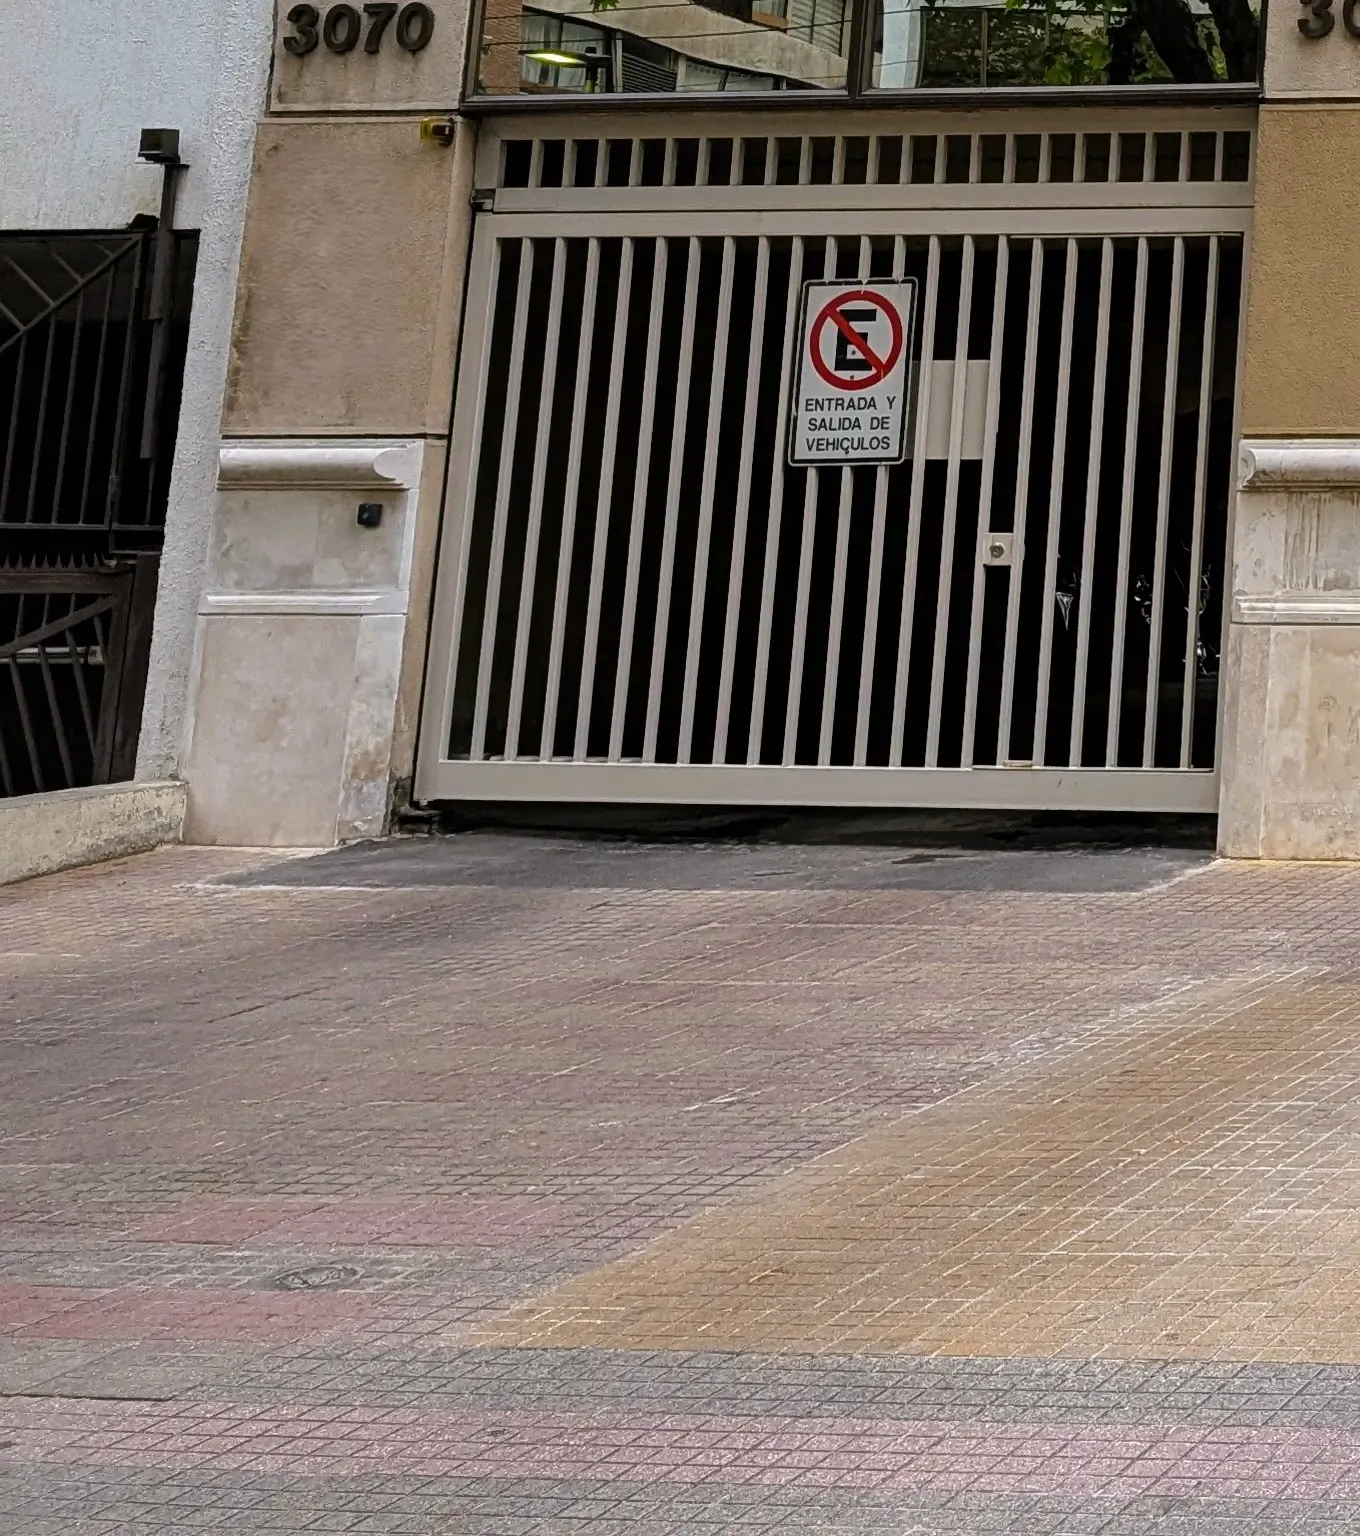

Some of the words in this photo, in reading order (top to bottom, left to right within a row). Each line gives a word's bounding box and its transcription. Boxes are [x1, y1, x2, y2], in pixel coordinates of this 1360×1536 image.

[282, 1, 435, 56] 3070
[804, 396, 878, 412] ENTRADA
[886, 395, 897, 410] Y
[807, 416, 862, 432] SALIDA
[870, 416, 890, 431] DE
[805, 435, 891, 453] VEHICULOS
